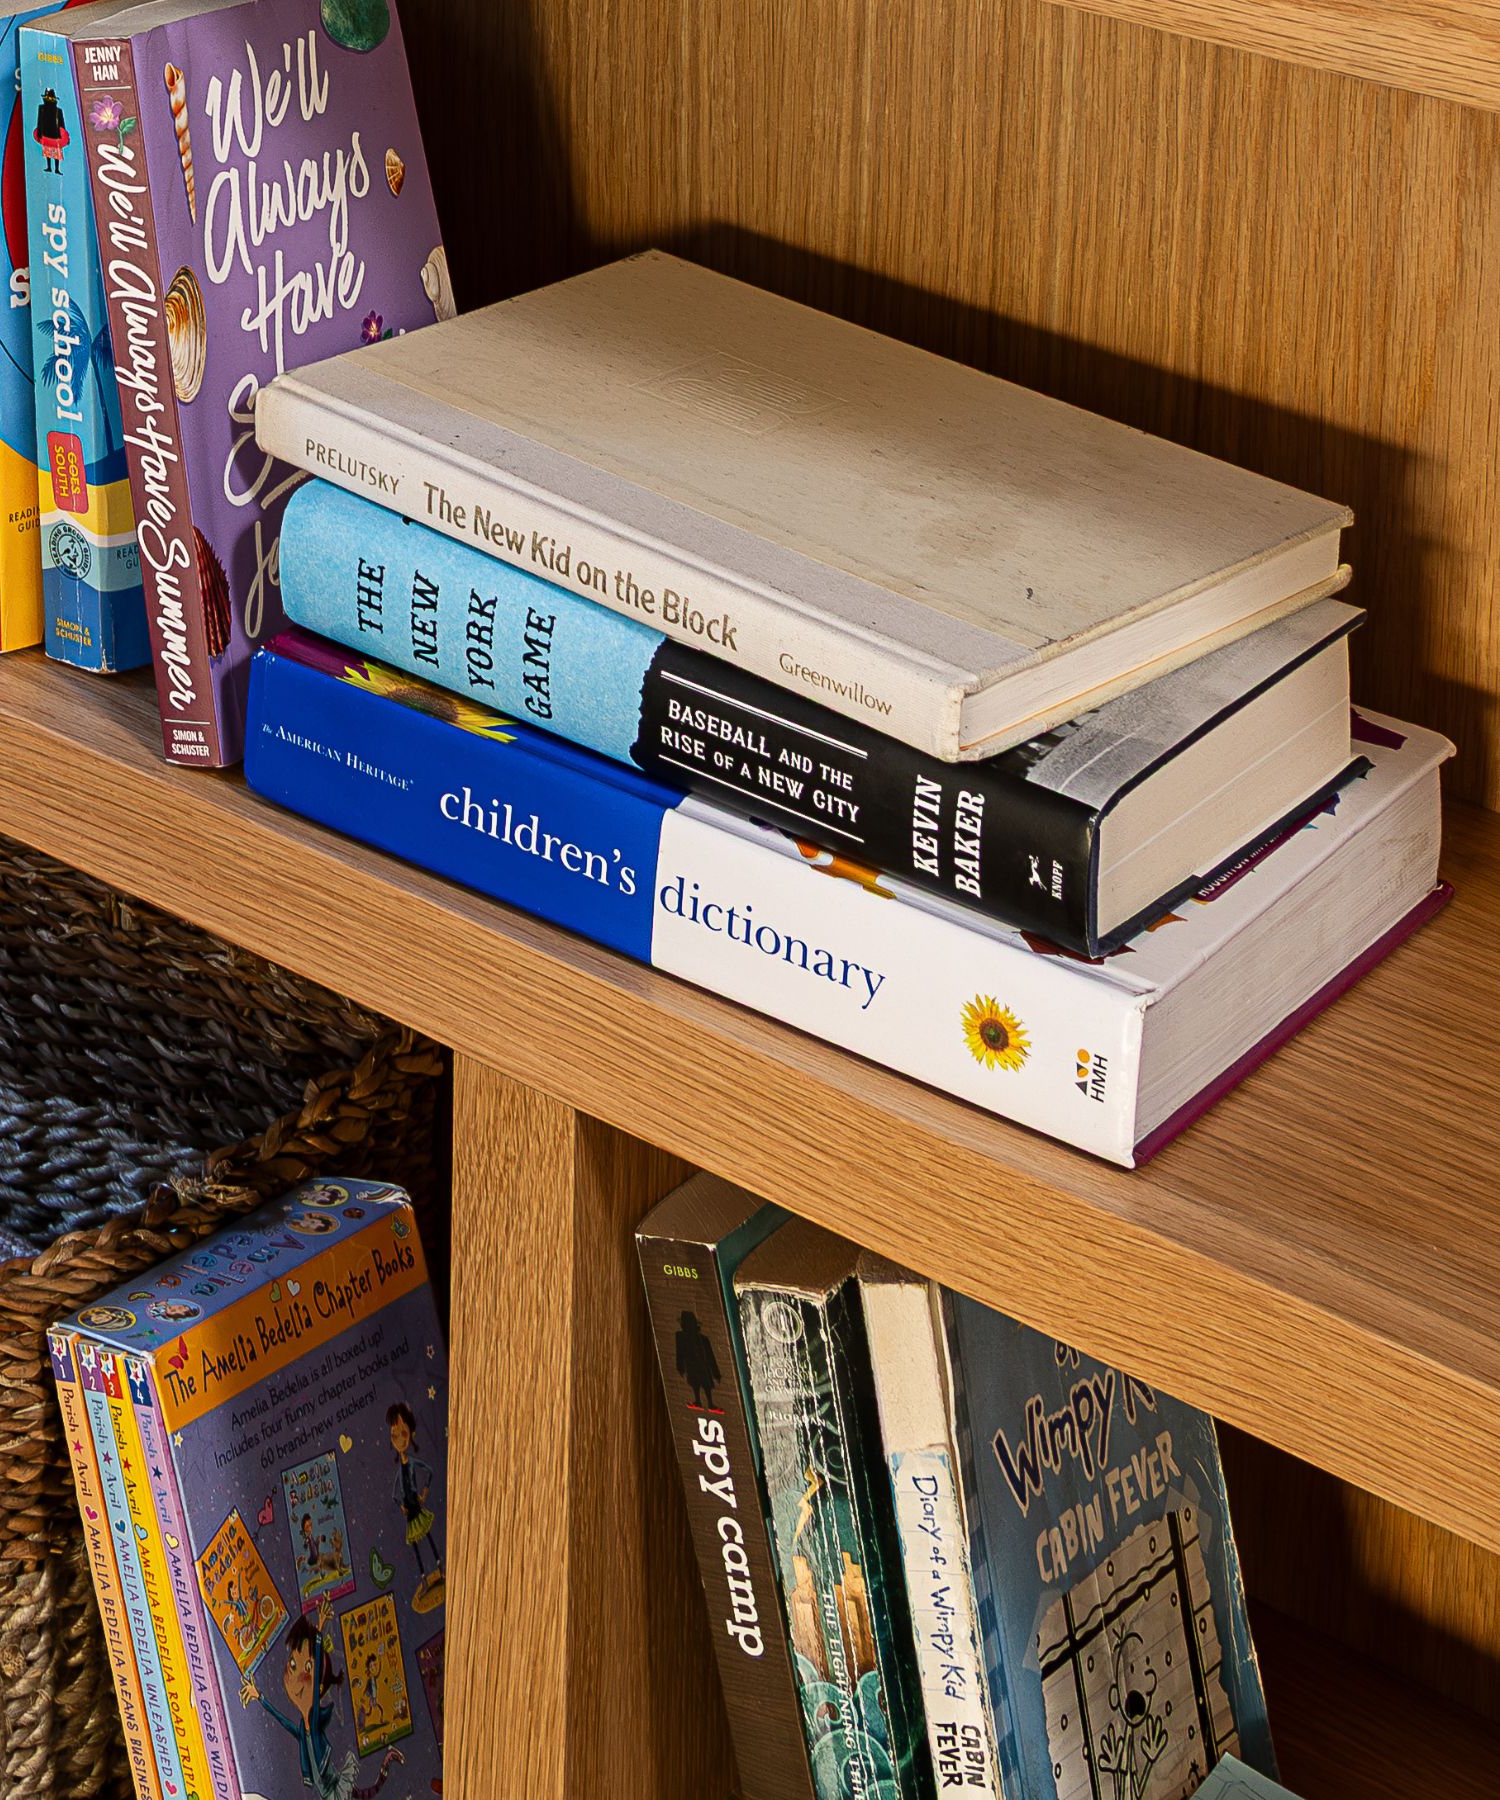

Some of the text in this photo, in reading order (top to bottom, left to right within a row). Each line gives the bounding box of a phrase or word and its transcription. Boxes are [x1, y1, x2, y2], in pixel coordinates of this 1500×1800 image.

[204, 131, 370, 284] Always
[306, 438, 400, 496] PRELUTSKY
[357, 558, 385, 635] THE
[412, 570, 440, 669] NEW
[423, 481, 738, 653] The New Kid on the Block
[467, 588, 498, 690] YORK
[523, 607, 557, 720] GAME
[669, 699, 853, 791] BASEBALL AND THE
[439, 786, 638, 896] children's
[913, 774, 942, 877] KEVIN
[954, 790, 985, 898] BAKER
[659, 876, 888, 1010] dictionary
[164, 1369, 196, 1408] The
[200, 1334, 257, 1393] Amelia
[313, 1268, 372, 1318] Chapter
[371, 1240, 415, 1287] Books
[690, 1418, 764, 1658] spy camp
[1036, 1431, 1181, 1583] CABIN FEVER
